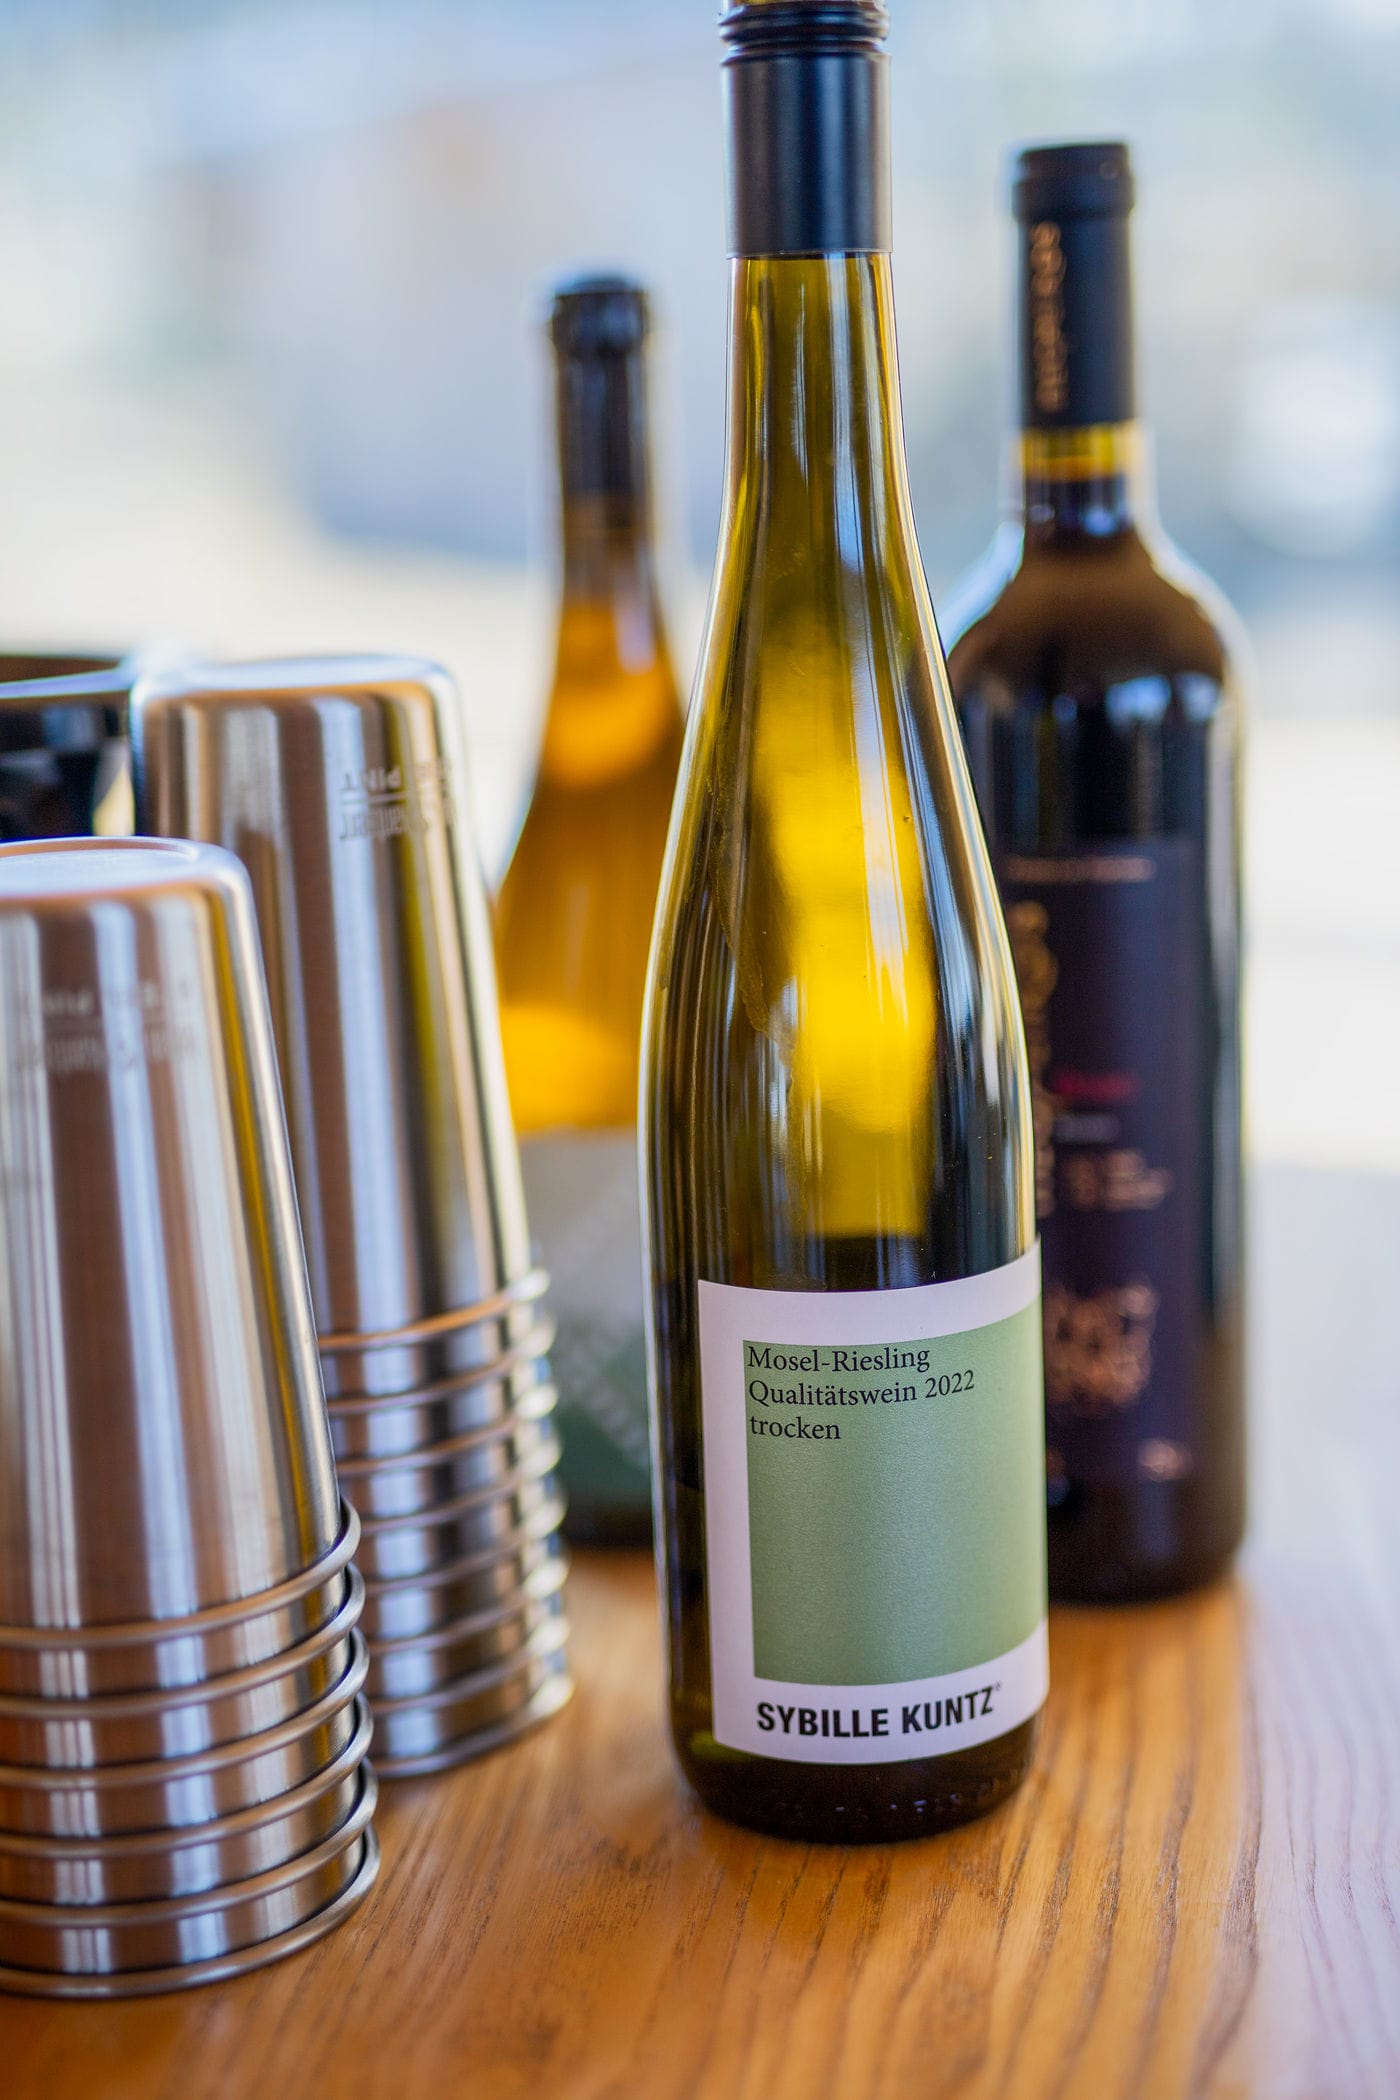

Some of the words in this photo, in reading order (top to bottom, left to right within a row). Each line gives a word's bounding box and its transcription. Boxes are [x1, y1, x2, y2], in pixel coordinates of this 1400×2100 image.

[747, 1346, 930, 1373] Mosel-Riesling
[749, 1379, 917, 1407] Qualitätswein
[924, 1369, 975, 1399] 2022
[750, 1416, 841, 1440] trocken
[756, 1702, 889, 1738] SYBILLE
